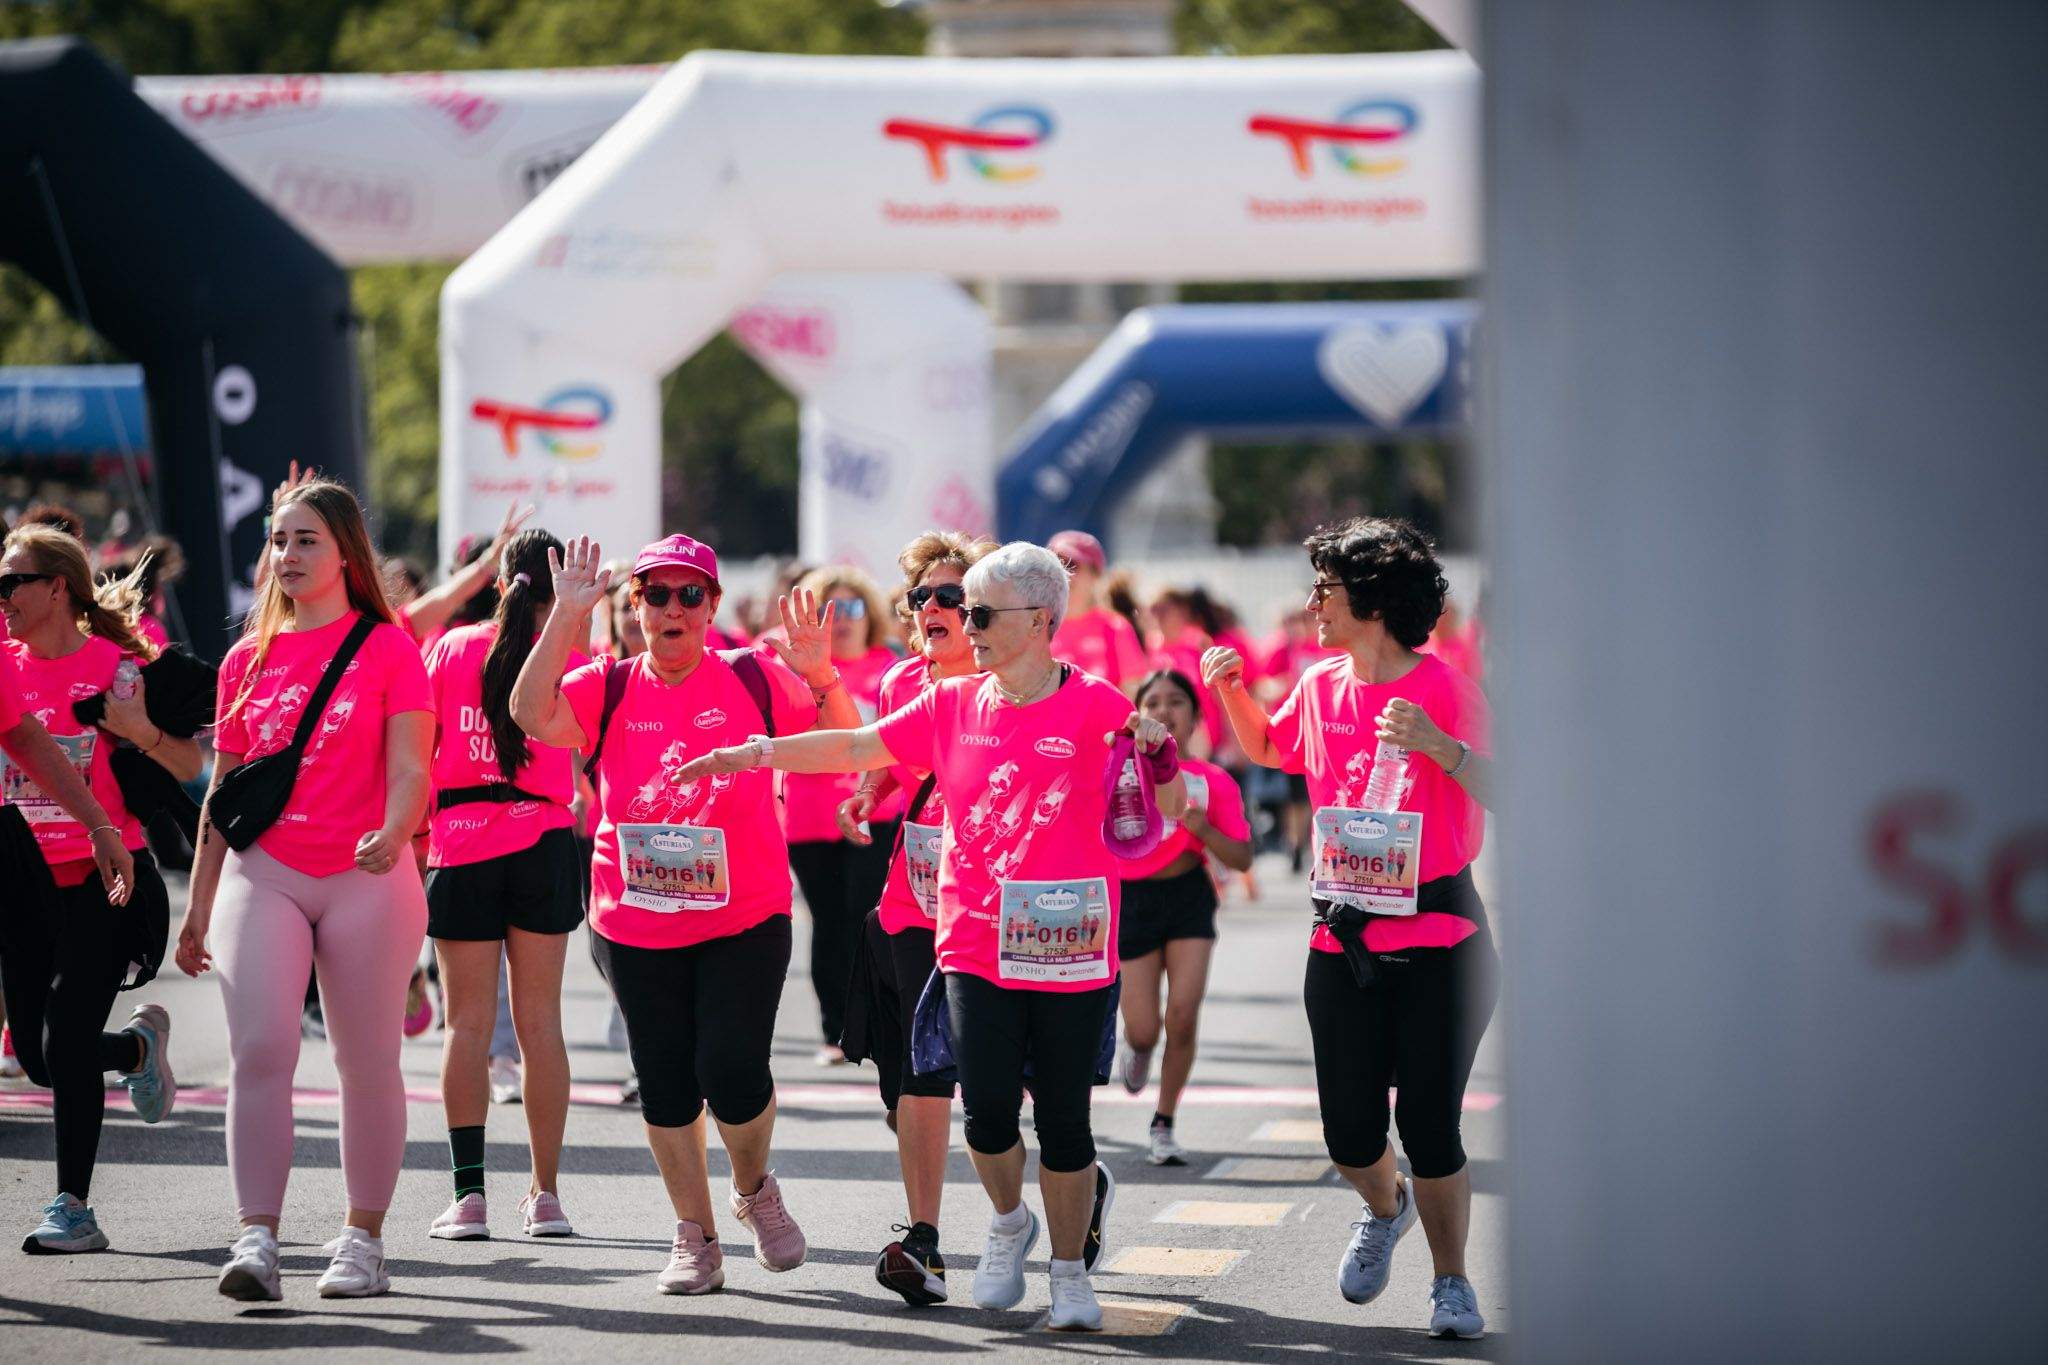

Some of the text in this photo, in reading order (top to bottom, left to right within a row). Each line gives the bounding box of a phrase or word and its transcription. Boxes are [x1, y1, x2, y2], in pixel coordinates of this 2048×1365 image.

[960, 733, 1000, 747] OYSHO
[1347, 824, 1386, 835] ASTURIANA
[1349, 854, 1384, 873] 016
[654, 866, 694, 883] 016
[1327, 882, 1350, 890] CARRERA
[634, 895, 667, 907] OYSHO
[1038, 897, 1078, 907] ASTURIANA
[1038, 926, 1078, 943] 016
[1012, 954, 1037, 962] CARRERA
[1010, 964, 1047, 976] OYSHO
